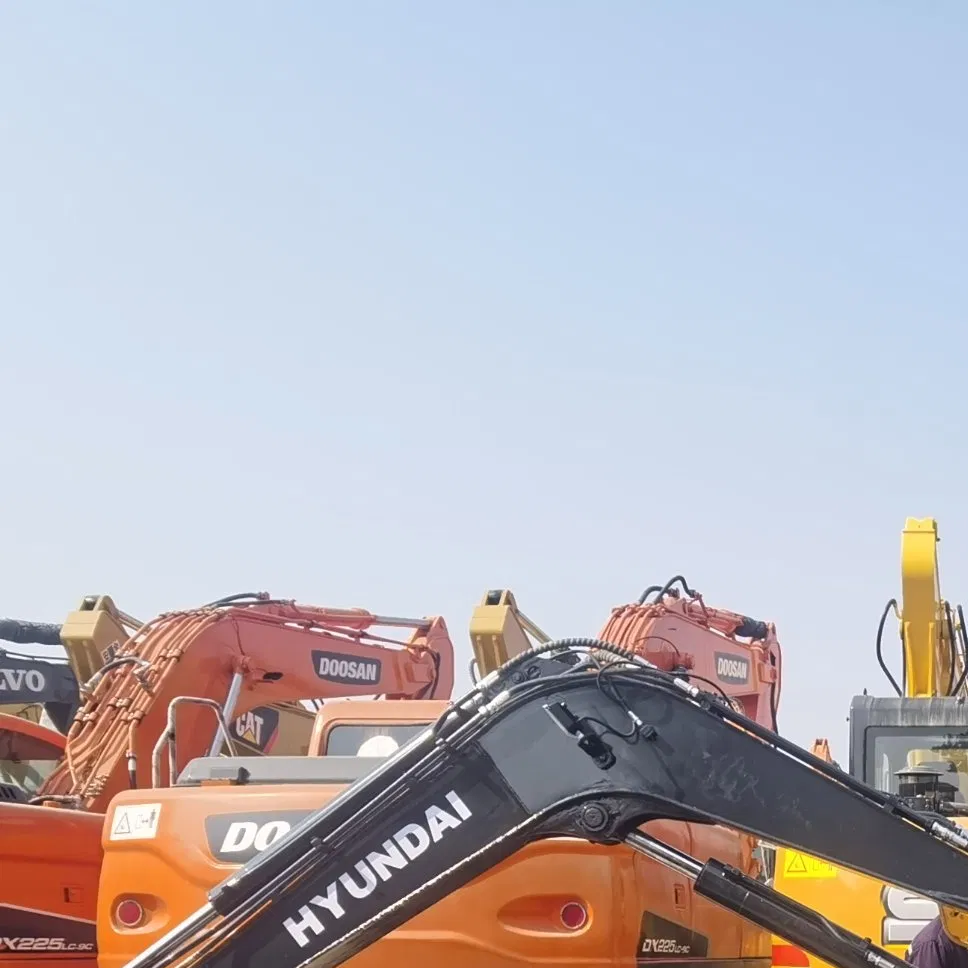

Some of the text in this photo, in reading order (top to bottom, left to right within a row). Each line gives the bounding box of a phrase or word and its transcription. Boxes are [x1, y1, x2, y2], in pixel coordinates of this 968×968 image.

[319, 657, 376, 681] DOOSAN
[717, 657, 747, 679] DOOSAN
[236, 711, 264, 745] CAT
[283, 790, 472, 948] HYUNDAI
